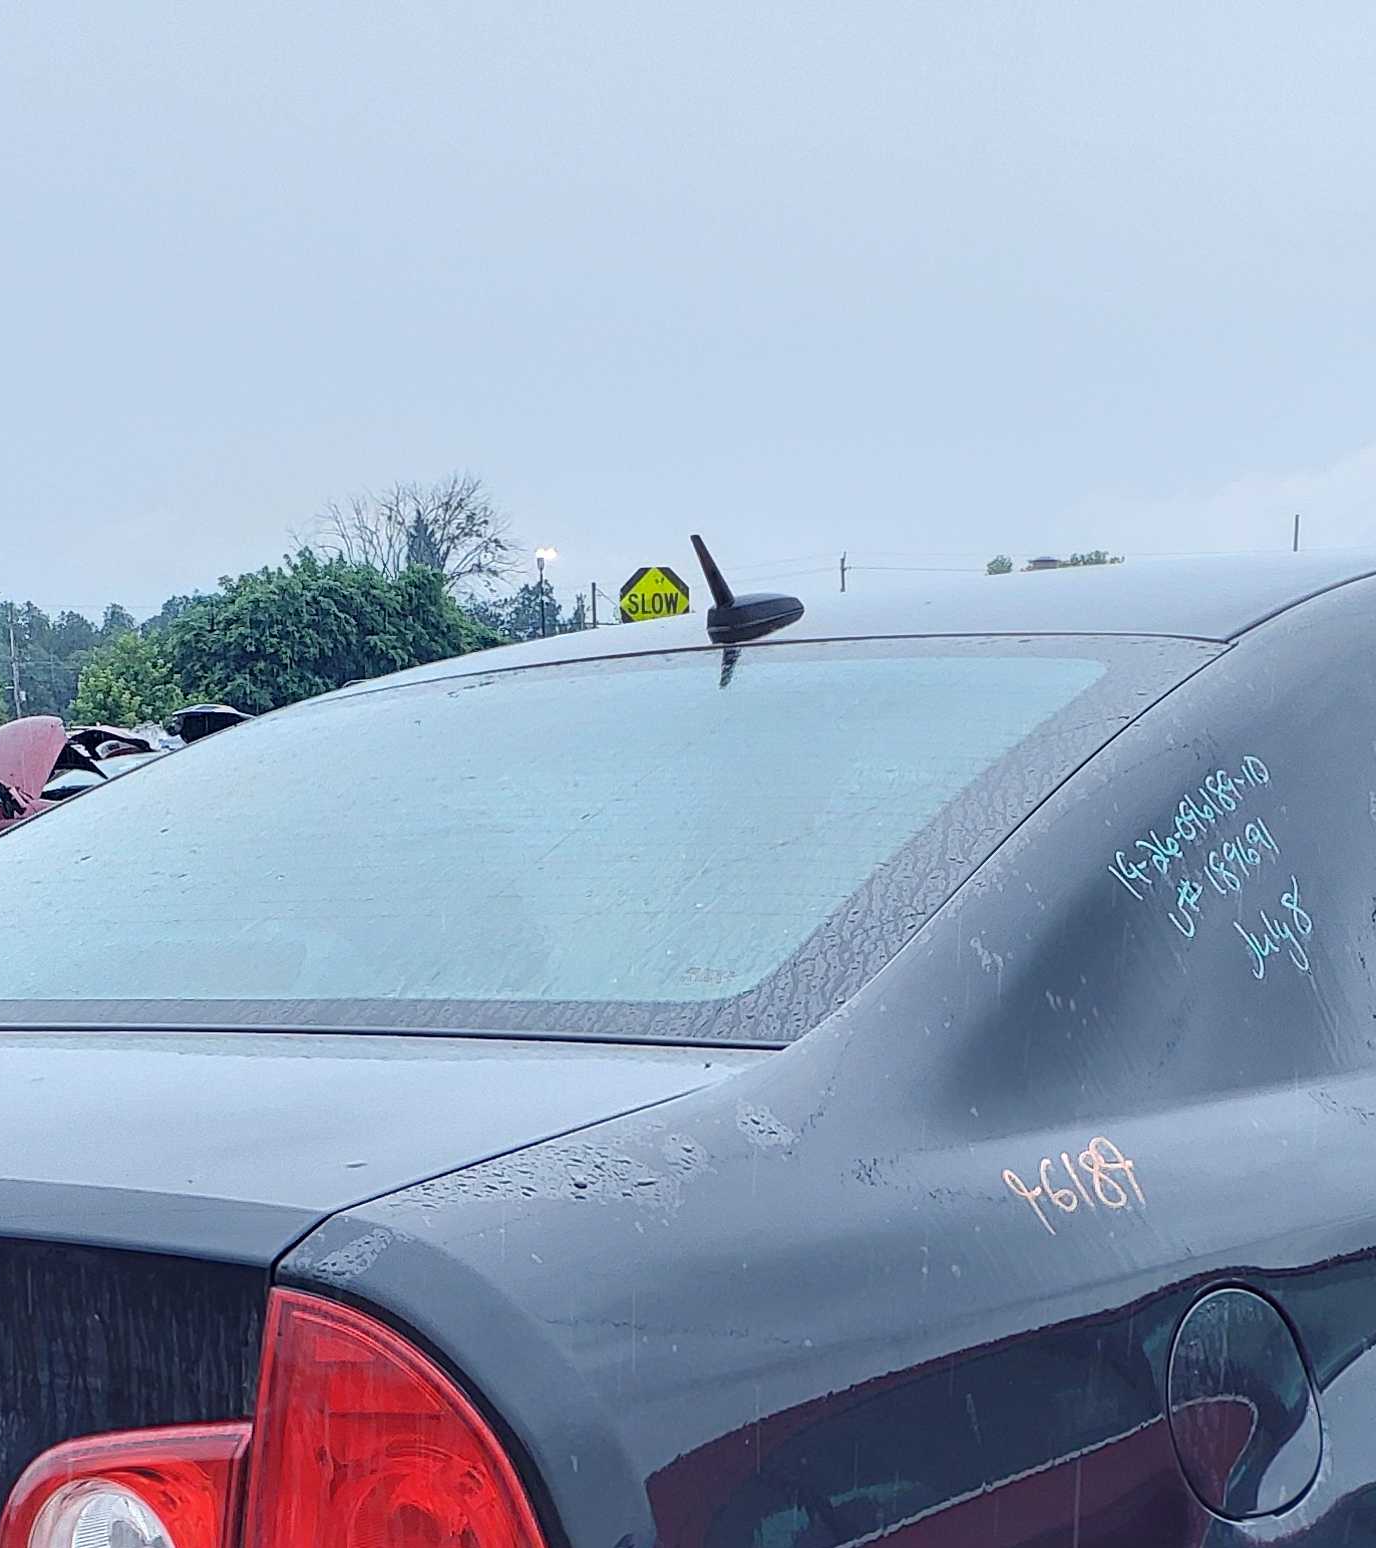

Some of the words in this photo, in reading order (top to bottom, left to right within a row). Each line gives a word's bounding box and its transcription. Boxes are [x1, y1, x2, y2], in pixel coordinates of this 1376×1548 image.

[628, 592, 679, 614] SLOW
[1233, 910, 1310, 980] July
[1280, 874, 1313, 935] 8
